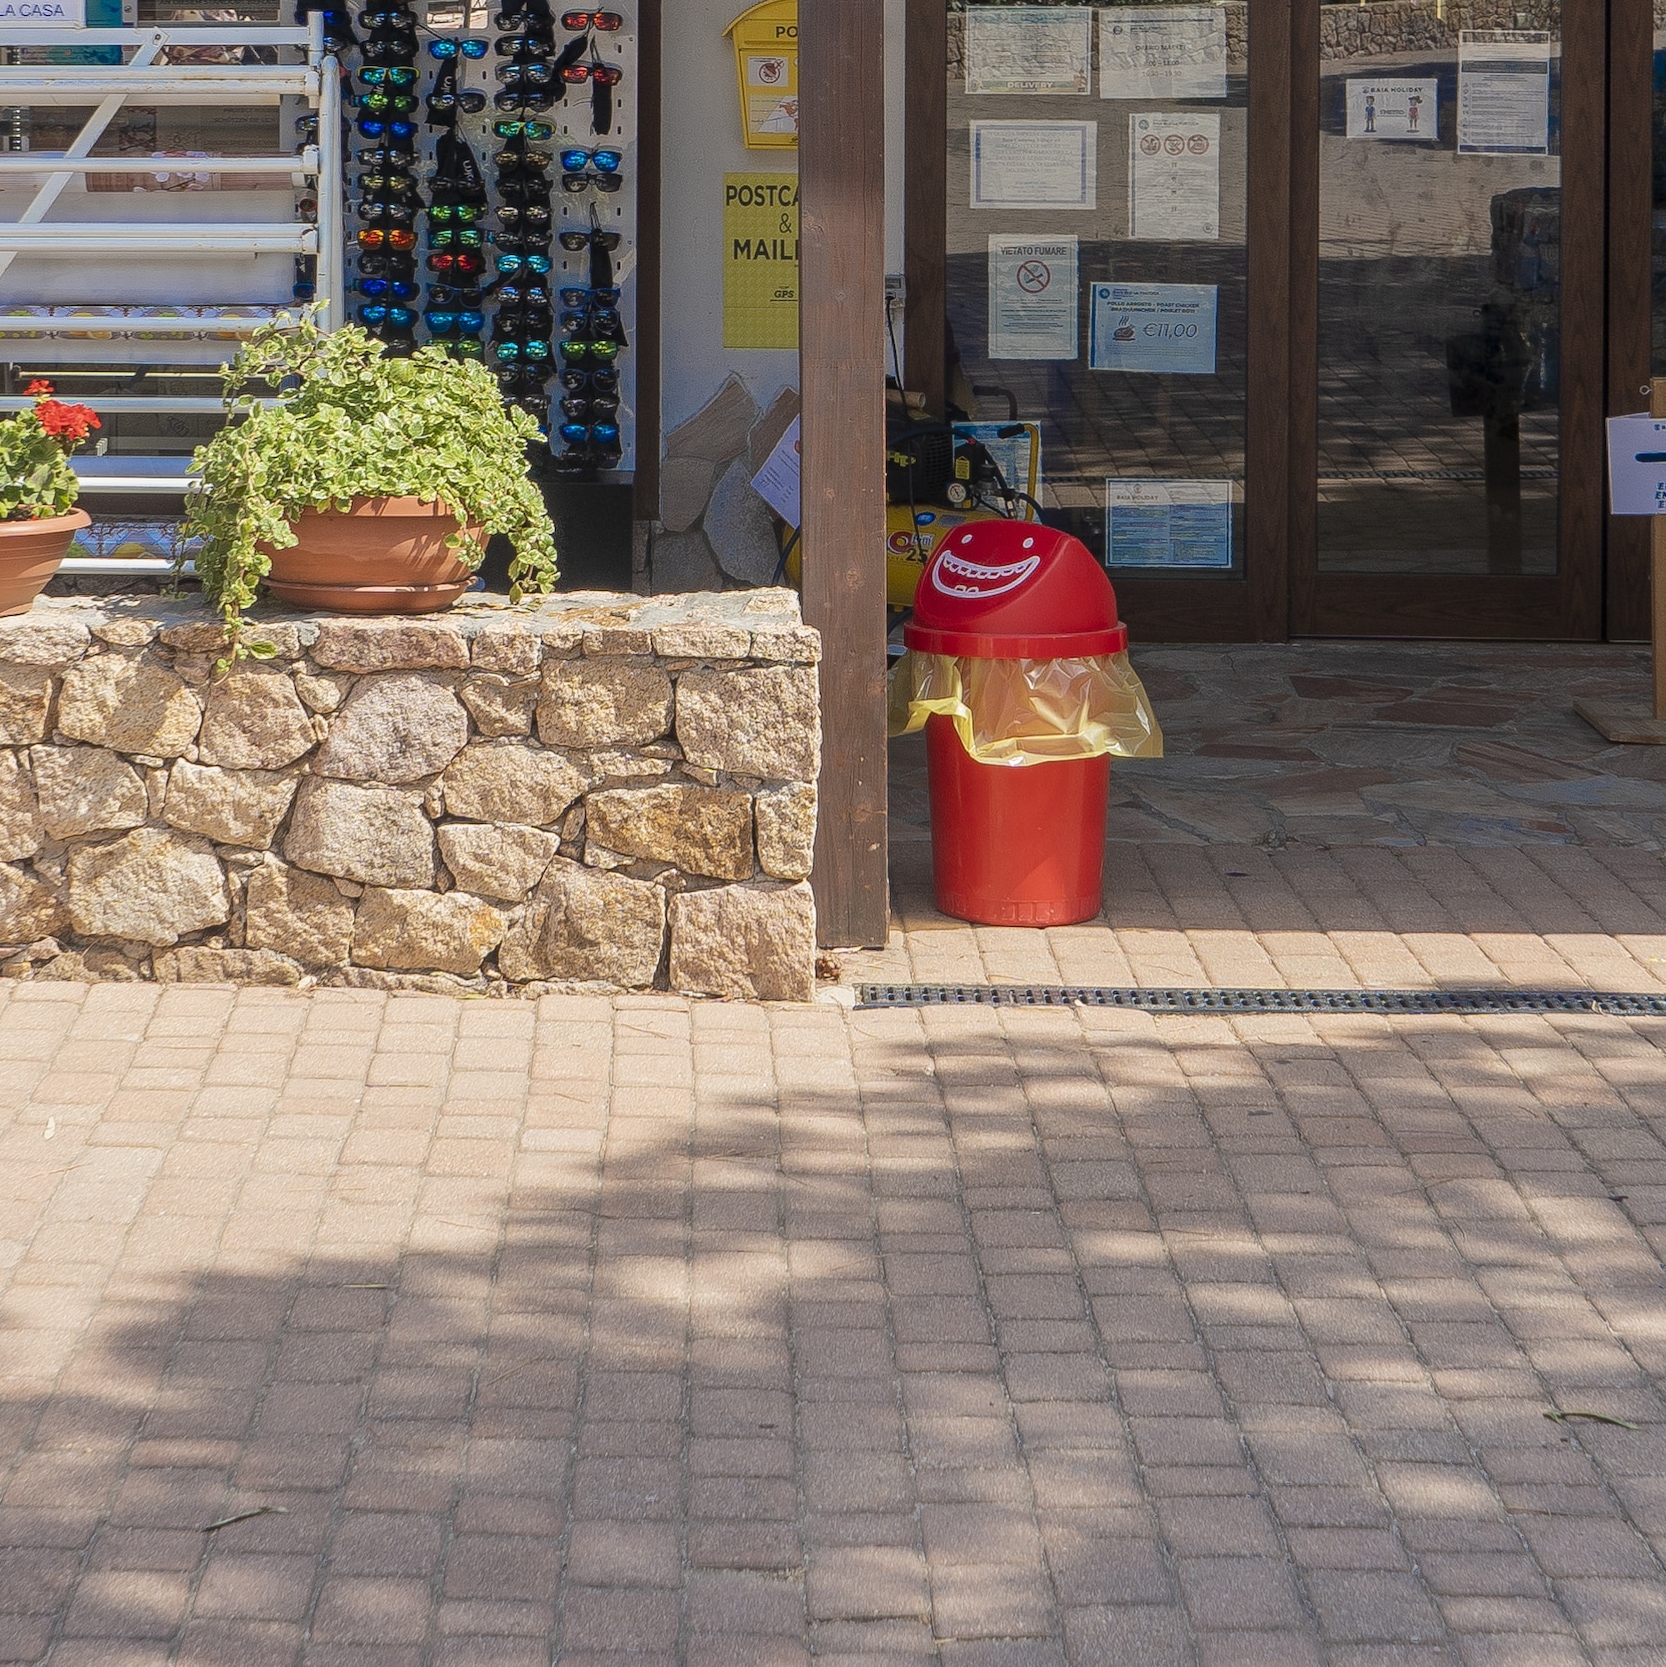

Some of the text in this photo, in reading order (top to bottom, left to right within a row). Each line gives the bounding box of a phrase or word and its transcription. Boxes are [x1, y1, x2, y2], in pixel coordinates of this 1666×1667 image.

[19, 2, 65, 17] CASA
[779, 213, 792, 234] &
[1000, 246, 1068, 256] VIETATO FUMARE
[773, 290, 795, 299] GPS
[1142, 322, 1198, 339] €11,00
